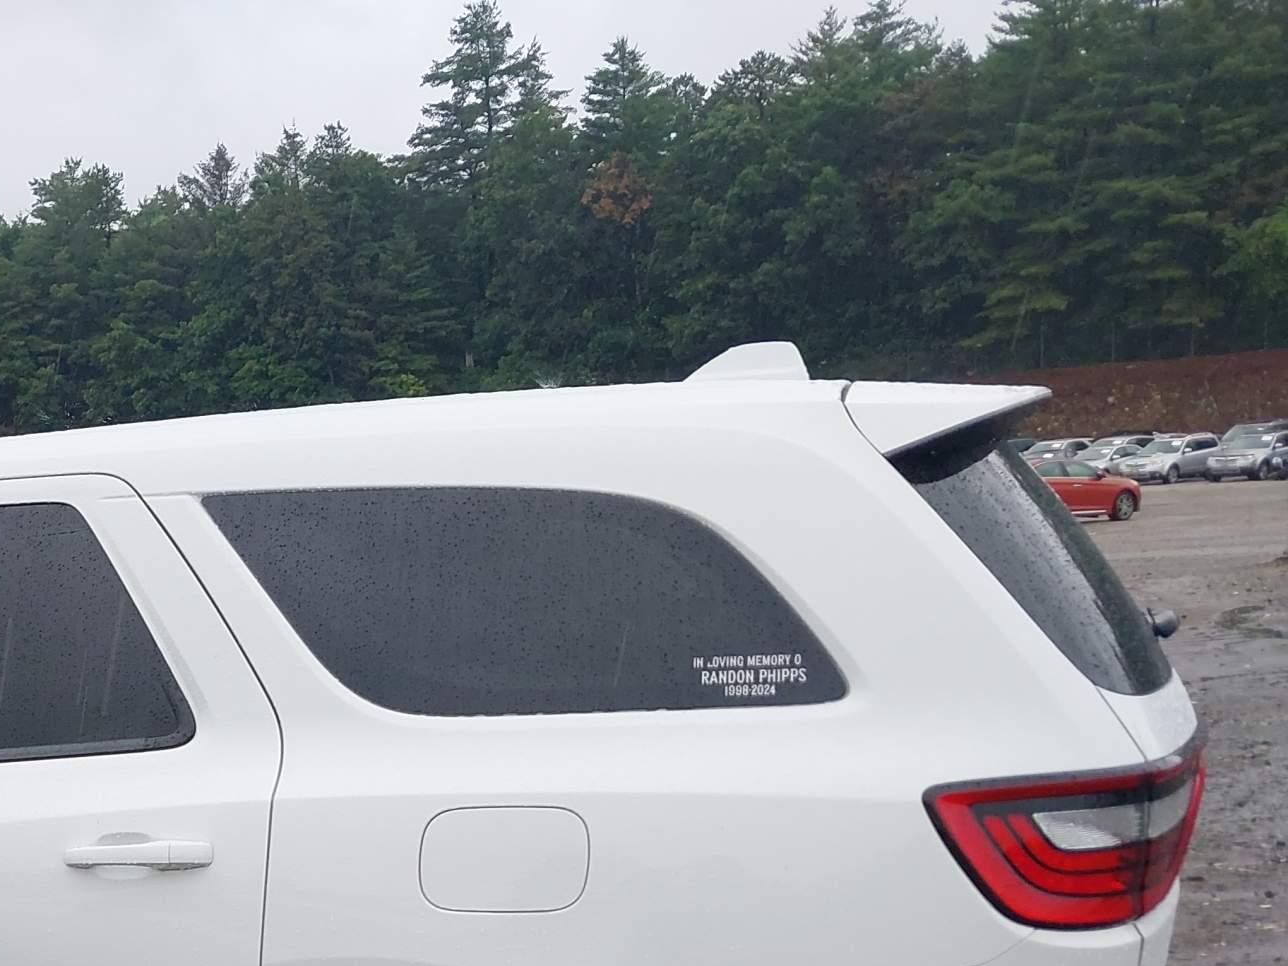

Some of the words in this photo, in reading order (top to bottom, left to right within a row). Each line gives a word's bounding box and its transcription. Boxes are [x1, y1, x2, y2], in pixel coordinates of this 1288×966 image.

[693, 657, 704, 668] IN
[747, 654, 791, 667] MEMORY
[701, 669, 754, 685] RANDON
[758, 668, 807, 683] PHIPPS
